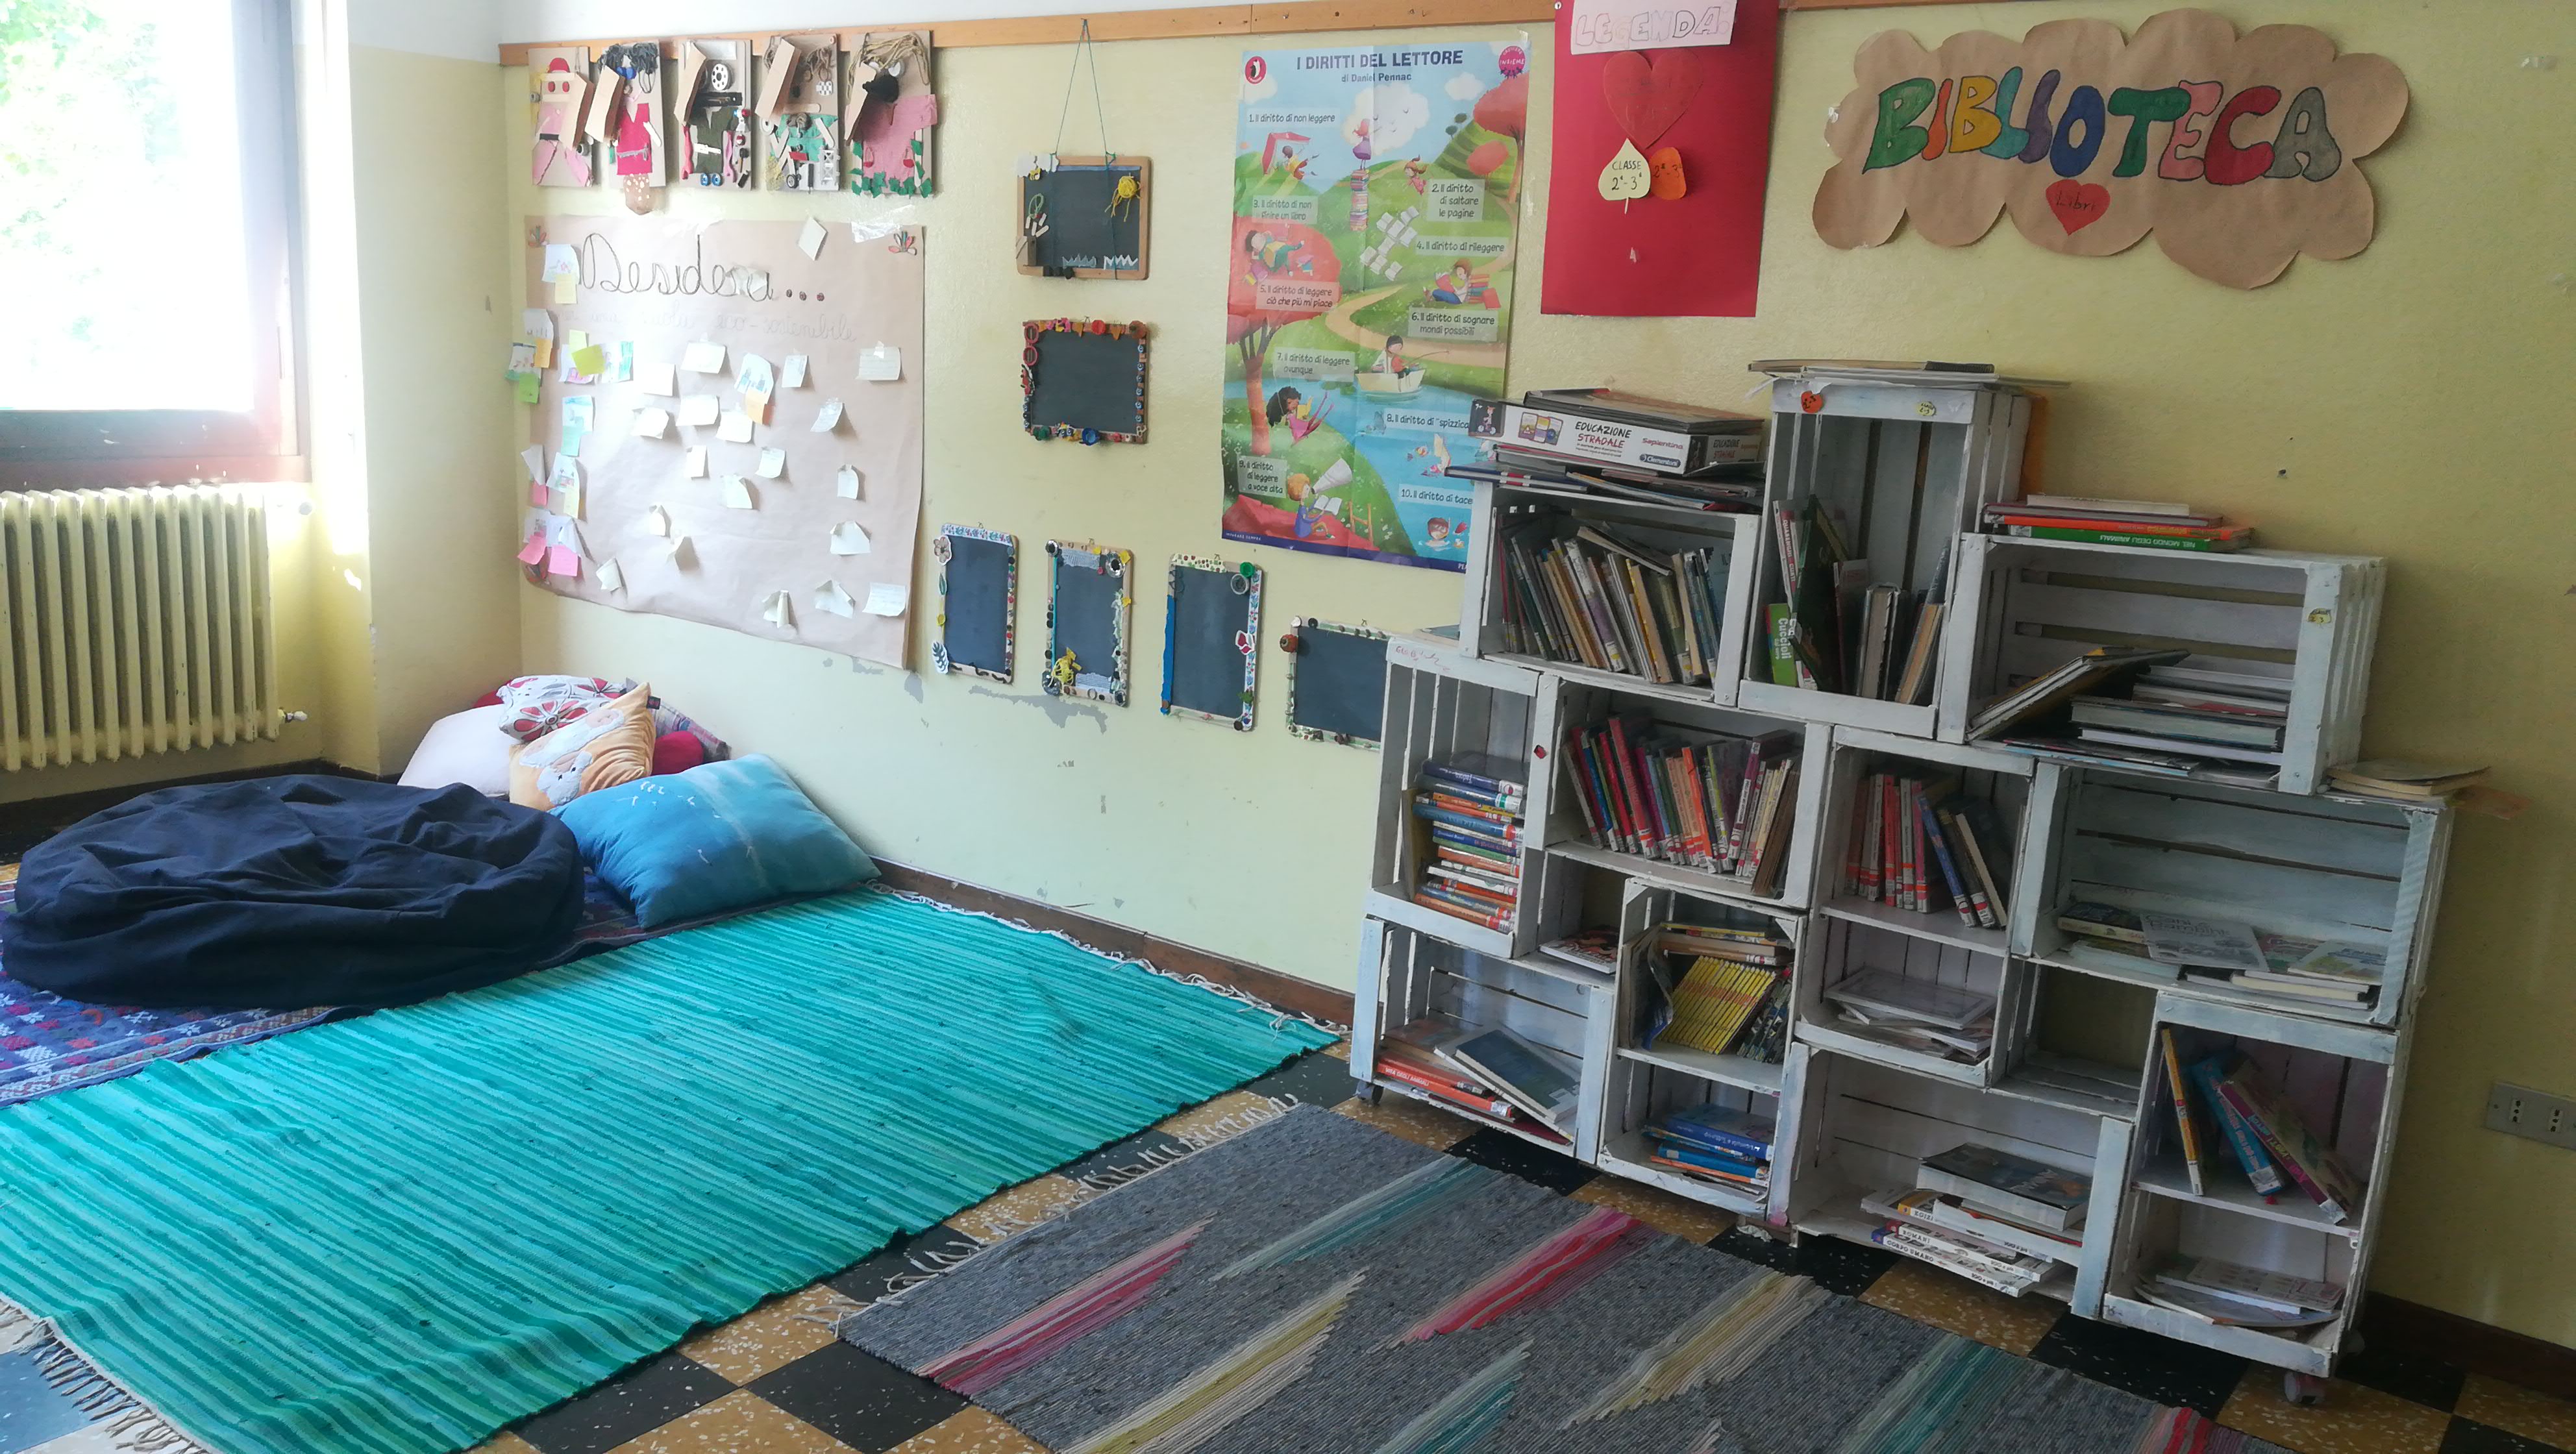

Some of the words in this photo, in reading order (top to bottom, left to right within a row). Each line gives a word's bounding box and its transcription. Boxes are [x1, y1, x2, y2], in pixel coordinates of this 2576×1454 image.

[1296, 56, 1301, 70] I
[1306, 55, 1355, 69] DIRITTI
[1360, 53, 1387, 68] DEL
[1393, 50, 1463, 67] LETTORE
[1341, 74, 1349, 82] di
[1351, 73, 1375, 82] Daniel
[1378, 73, 1412, 82] Pennac
[1260, 114, 1284, 123] diritto
[1285, 114, 1293, 123] di
[1308, 114, 1335, 124] leggere
[1861, 66, 2342, 186] BIBLIOTECA
[1611, 160, 1642, 171] CLASSE
[1446, 184, 1474, 193] diritto
[1266, 200, 1290, 208] diritto
[1291, 200, 1298, 208] di
[1440, 195, 1447, 205] di
[1449, 196, 1479, 205] saltare
[1439, 208, 1446, 217] le
[1448, 208, 1475, 219] pagine
[1431, 241, 1458, 251] diritto
[1459, 242, 1468, 251] di
[1469, 242, 1505, 253] rileggere
[1272, 285, 1296, 295] diritto
[1297, 286, 1305, 295] di
[1306, 287, 1332, 297] leggere
[1291, 298, 1302, 307] più
[1303, 298, 1312, 306] mi
[1313, 299, 1333, 308] piace
[1426, 312, 1452, 323] diritto
[1463, 316, 1495, 325] sognare
[1420, 325, 1443, 334] mondi
[1444, 327, 1475, 336] possibili
[1289, 353, 1313, 363] diritto
[1315, 355, 1322, 364] di
[1322, 355, 1350, 366] leggere
[1283, 365, 1313, 375] ovunque
[1400, 415, 1426, 425] diritto
[1427, 417, 1434, 426] di
[1575, 421, 1632, 439] EDUCAZIONE
[1577, 432, 1626, 449] STRADALE
[1251, 461, 1274, 471] diritto
[1647, 455, 1678, 466] Clementoni
[1254, 472, 1278, 483] leggere
[1254, 484, 1268, 493] voce
[1269, 485, 1283, 494] alta
[1418, 491, 1444, 502] diritto
[1446, 494, 1454, 502] di
[2153, 539, 2180, 547] MONDO
[1886, 1239, 1909, 1253] CORPO
[1909, 1248, 1935, 1263] UMANO
